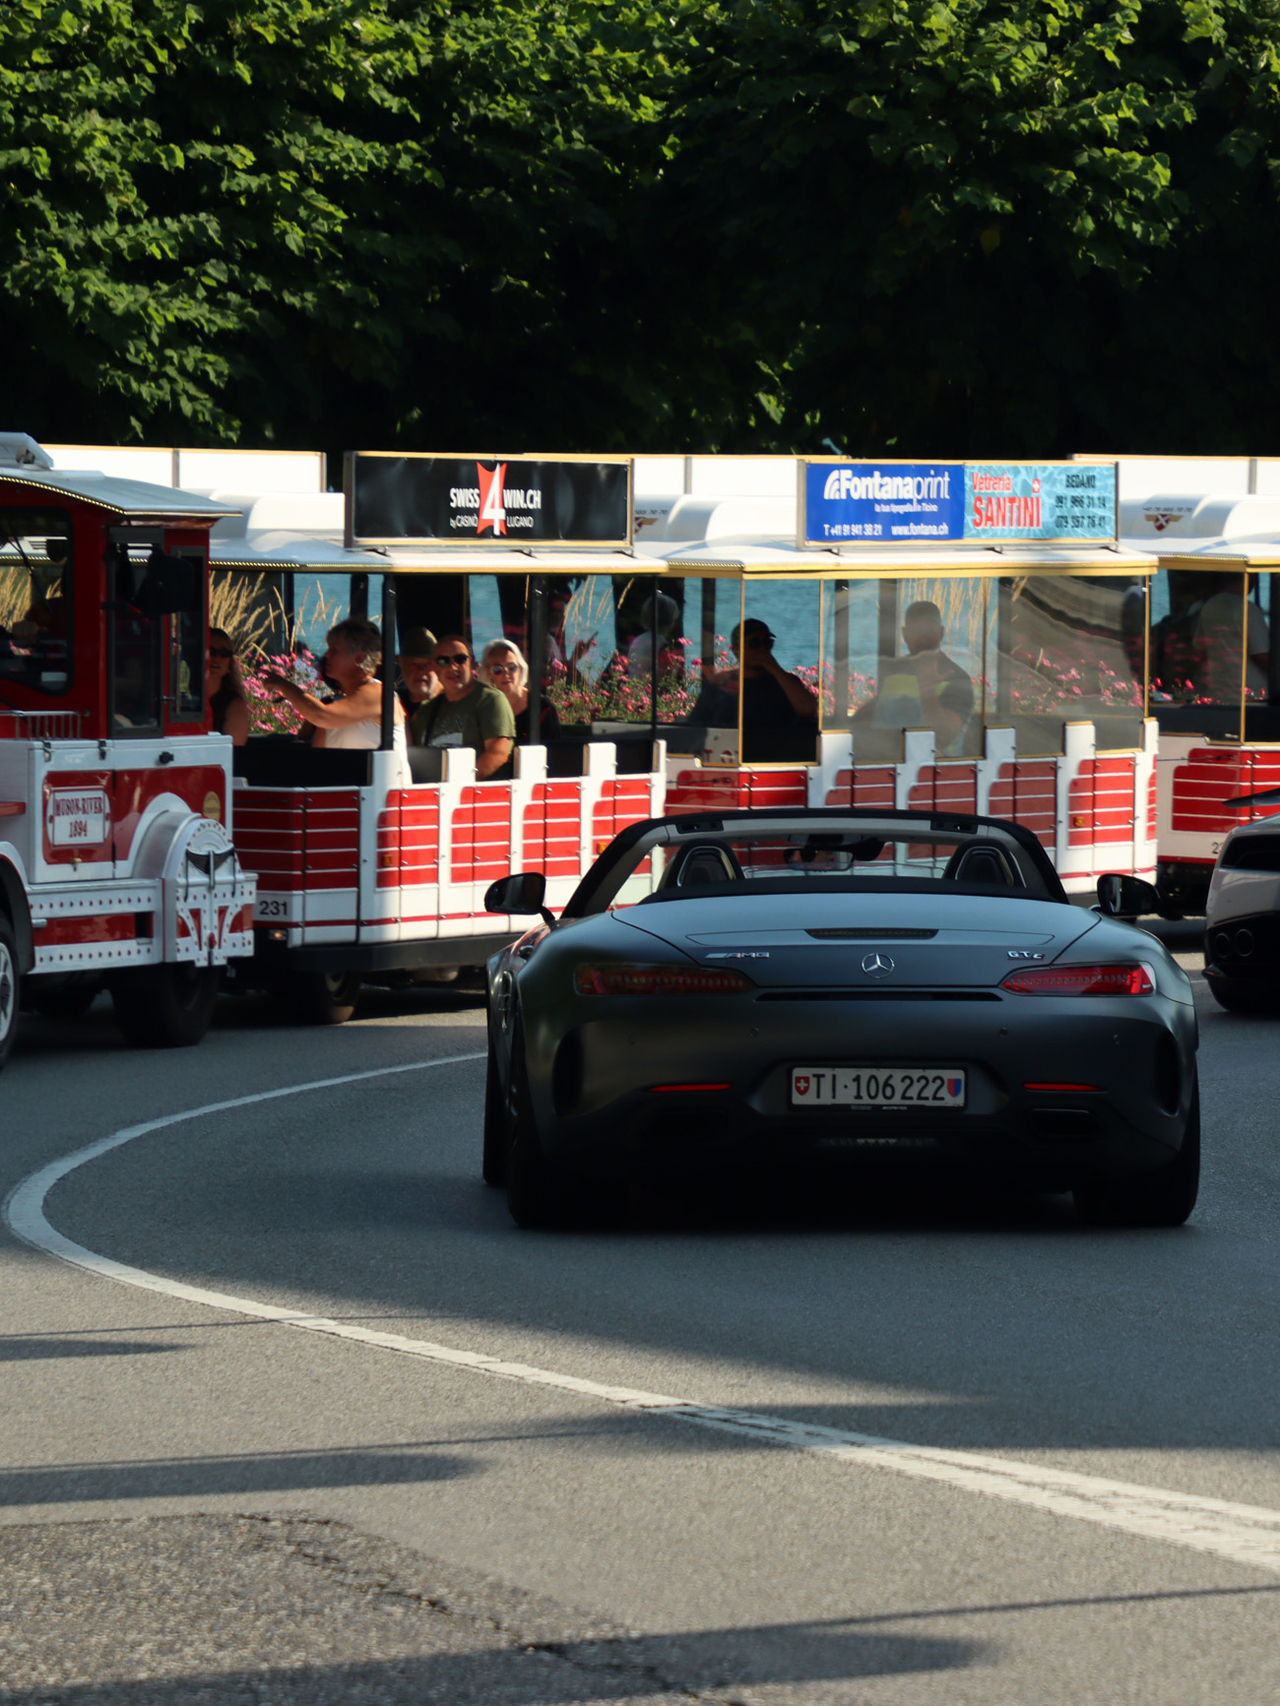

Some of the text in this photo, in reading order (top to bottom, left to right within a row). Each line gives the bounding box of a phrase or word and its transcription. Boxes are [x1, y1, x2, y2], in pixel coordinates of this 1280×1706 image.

[971, 472, 1013, 492] Vetreria
[449, 487, 480, 508] SWISS
[502, 489, 542, 510] WIN.CH
[506, 516, 534, 528] LUGANO
[973, 496, 1042, 529] SANTINI
[259, 900, 288, 915] 231
